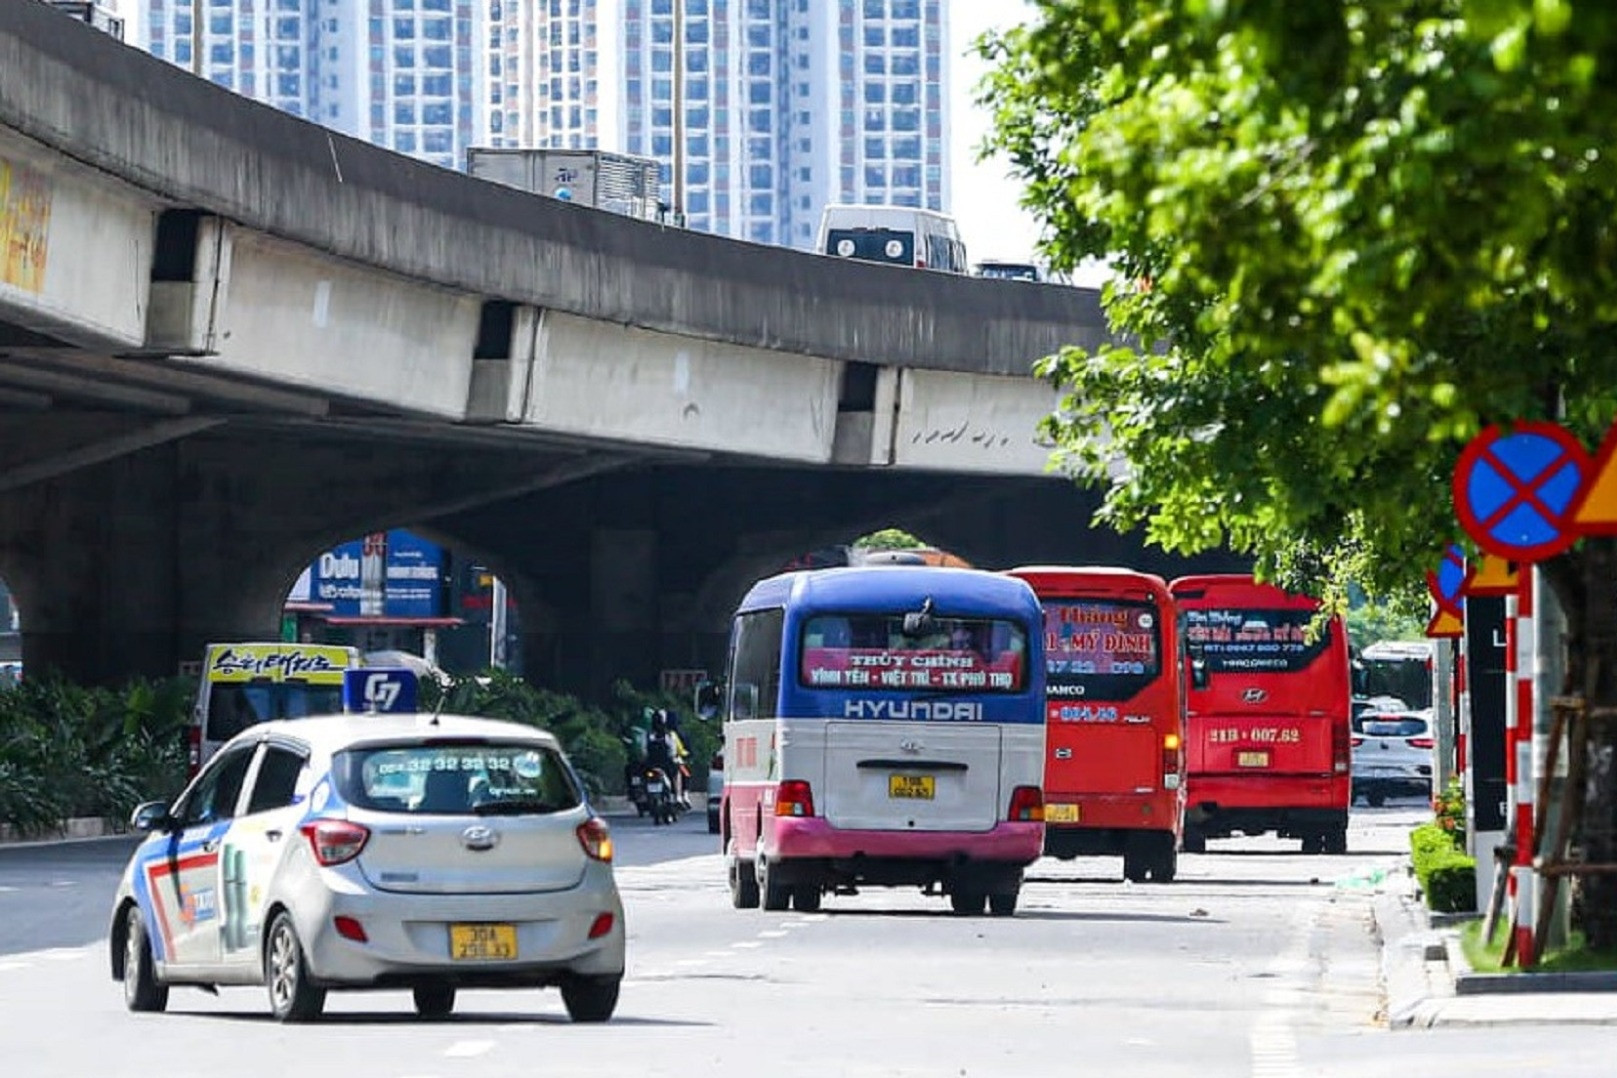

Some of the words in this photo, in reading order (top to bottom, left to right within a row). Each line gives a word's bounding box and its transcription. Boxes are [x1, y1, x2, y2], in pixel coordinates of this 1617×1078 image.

[844, 668, 870, 685] YÊN
[881, 669, 907, 687] VIỆT
[989, 671, 1013, 689] THỌ
[363, 673, 402, 711] G7
[844, 699, 984, 722] HYUNDAI
[434, 756, 458, 771] 32
[460, 756, 485, 771] 32
[487, 756, 511, 771] 32
